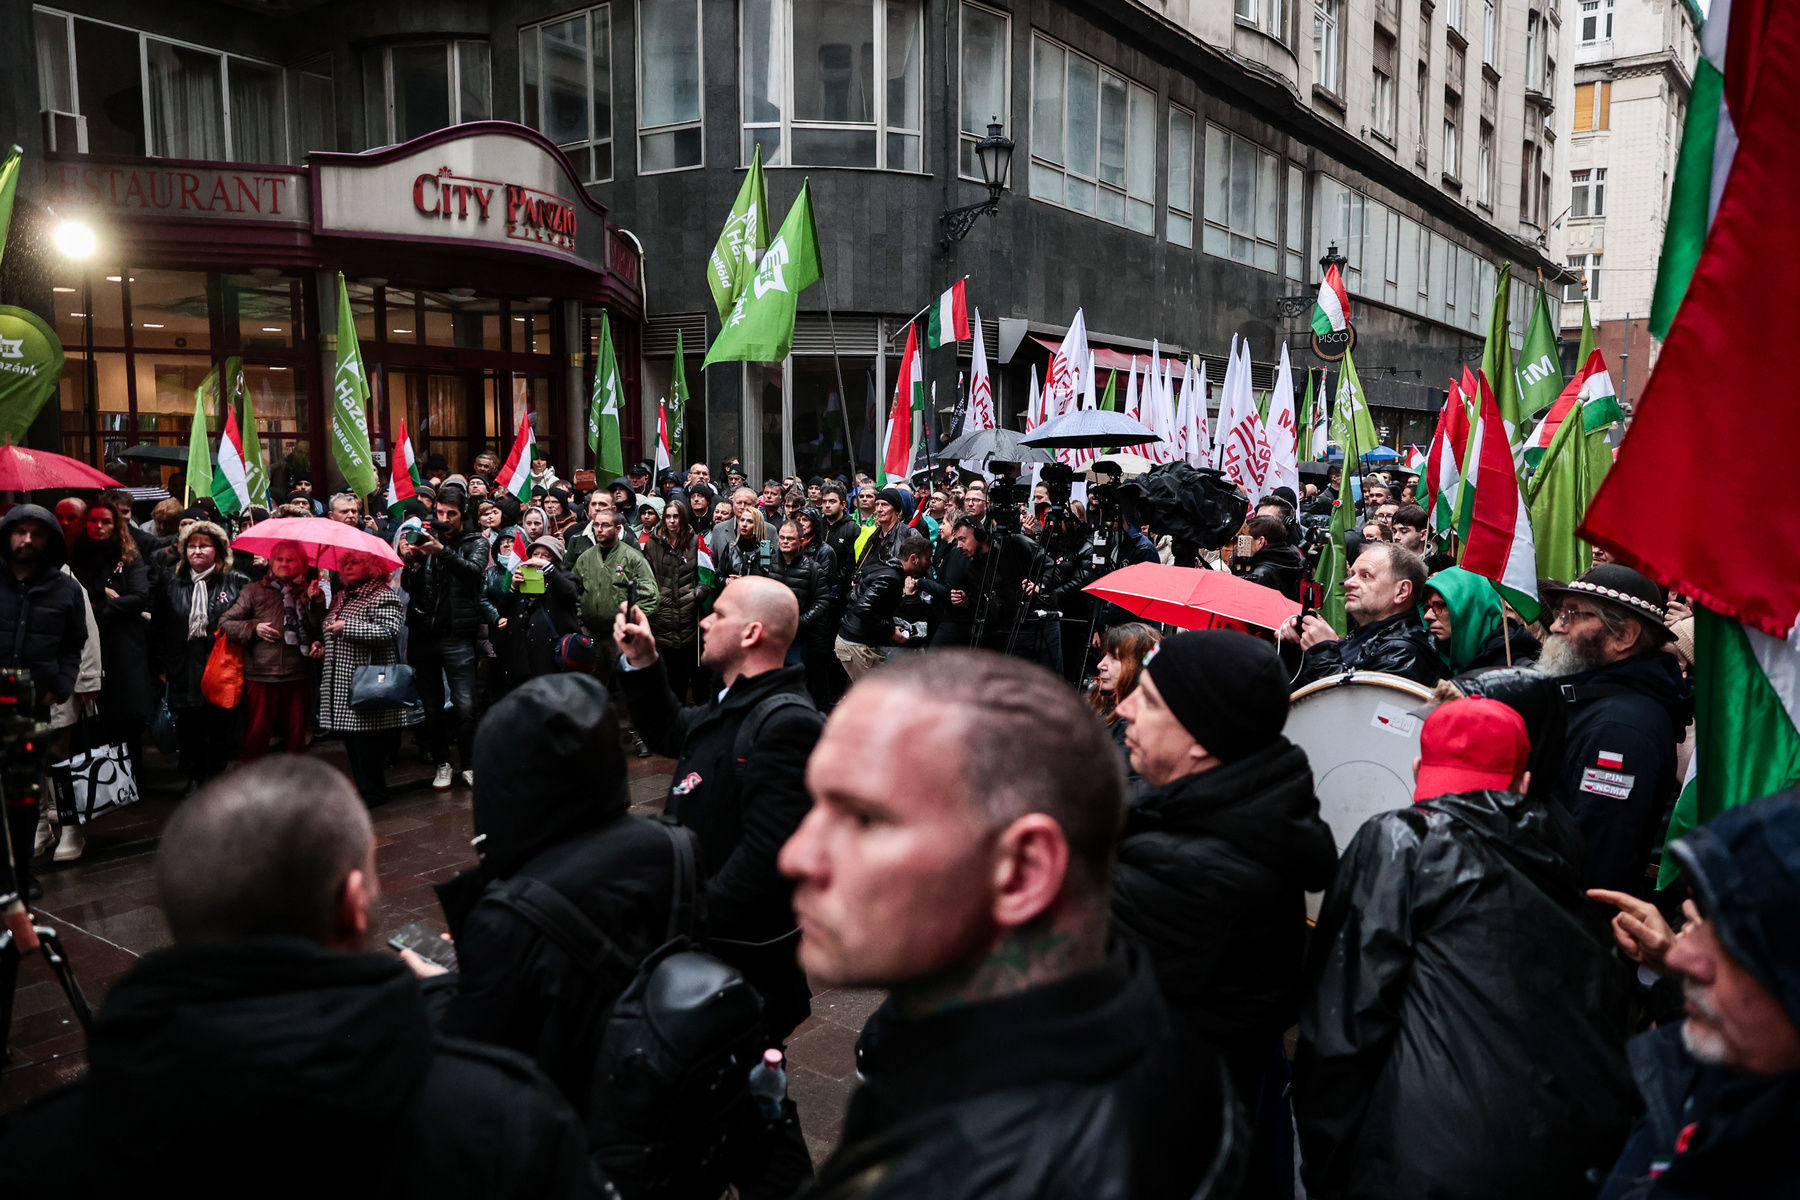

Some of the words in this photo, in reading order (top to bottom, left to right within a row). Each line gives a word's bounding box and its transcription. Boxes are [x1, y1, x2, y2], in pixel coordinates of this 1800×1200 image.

[45, 164, 286, 214] ESTAURANT
[1318, 332, 1349, 343] PISCO
[0, 361, 38, 376] azánk
[976, 397, 994, 429] Haz
[1605, 773, 1623, 782] PIN
[1596, 784, 1626, 795] NCMA
